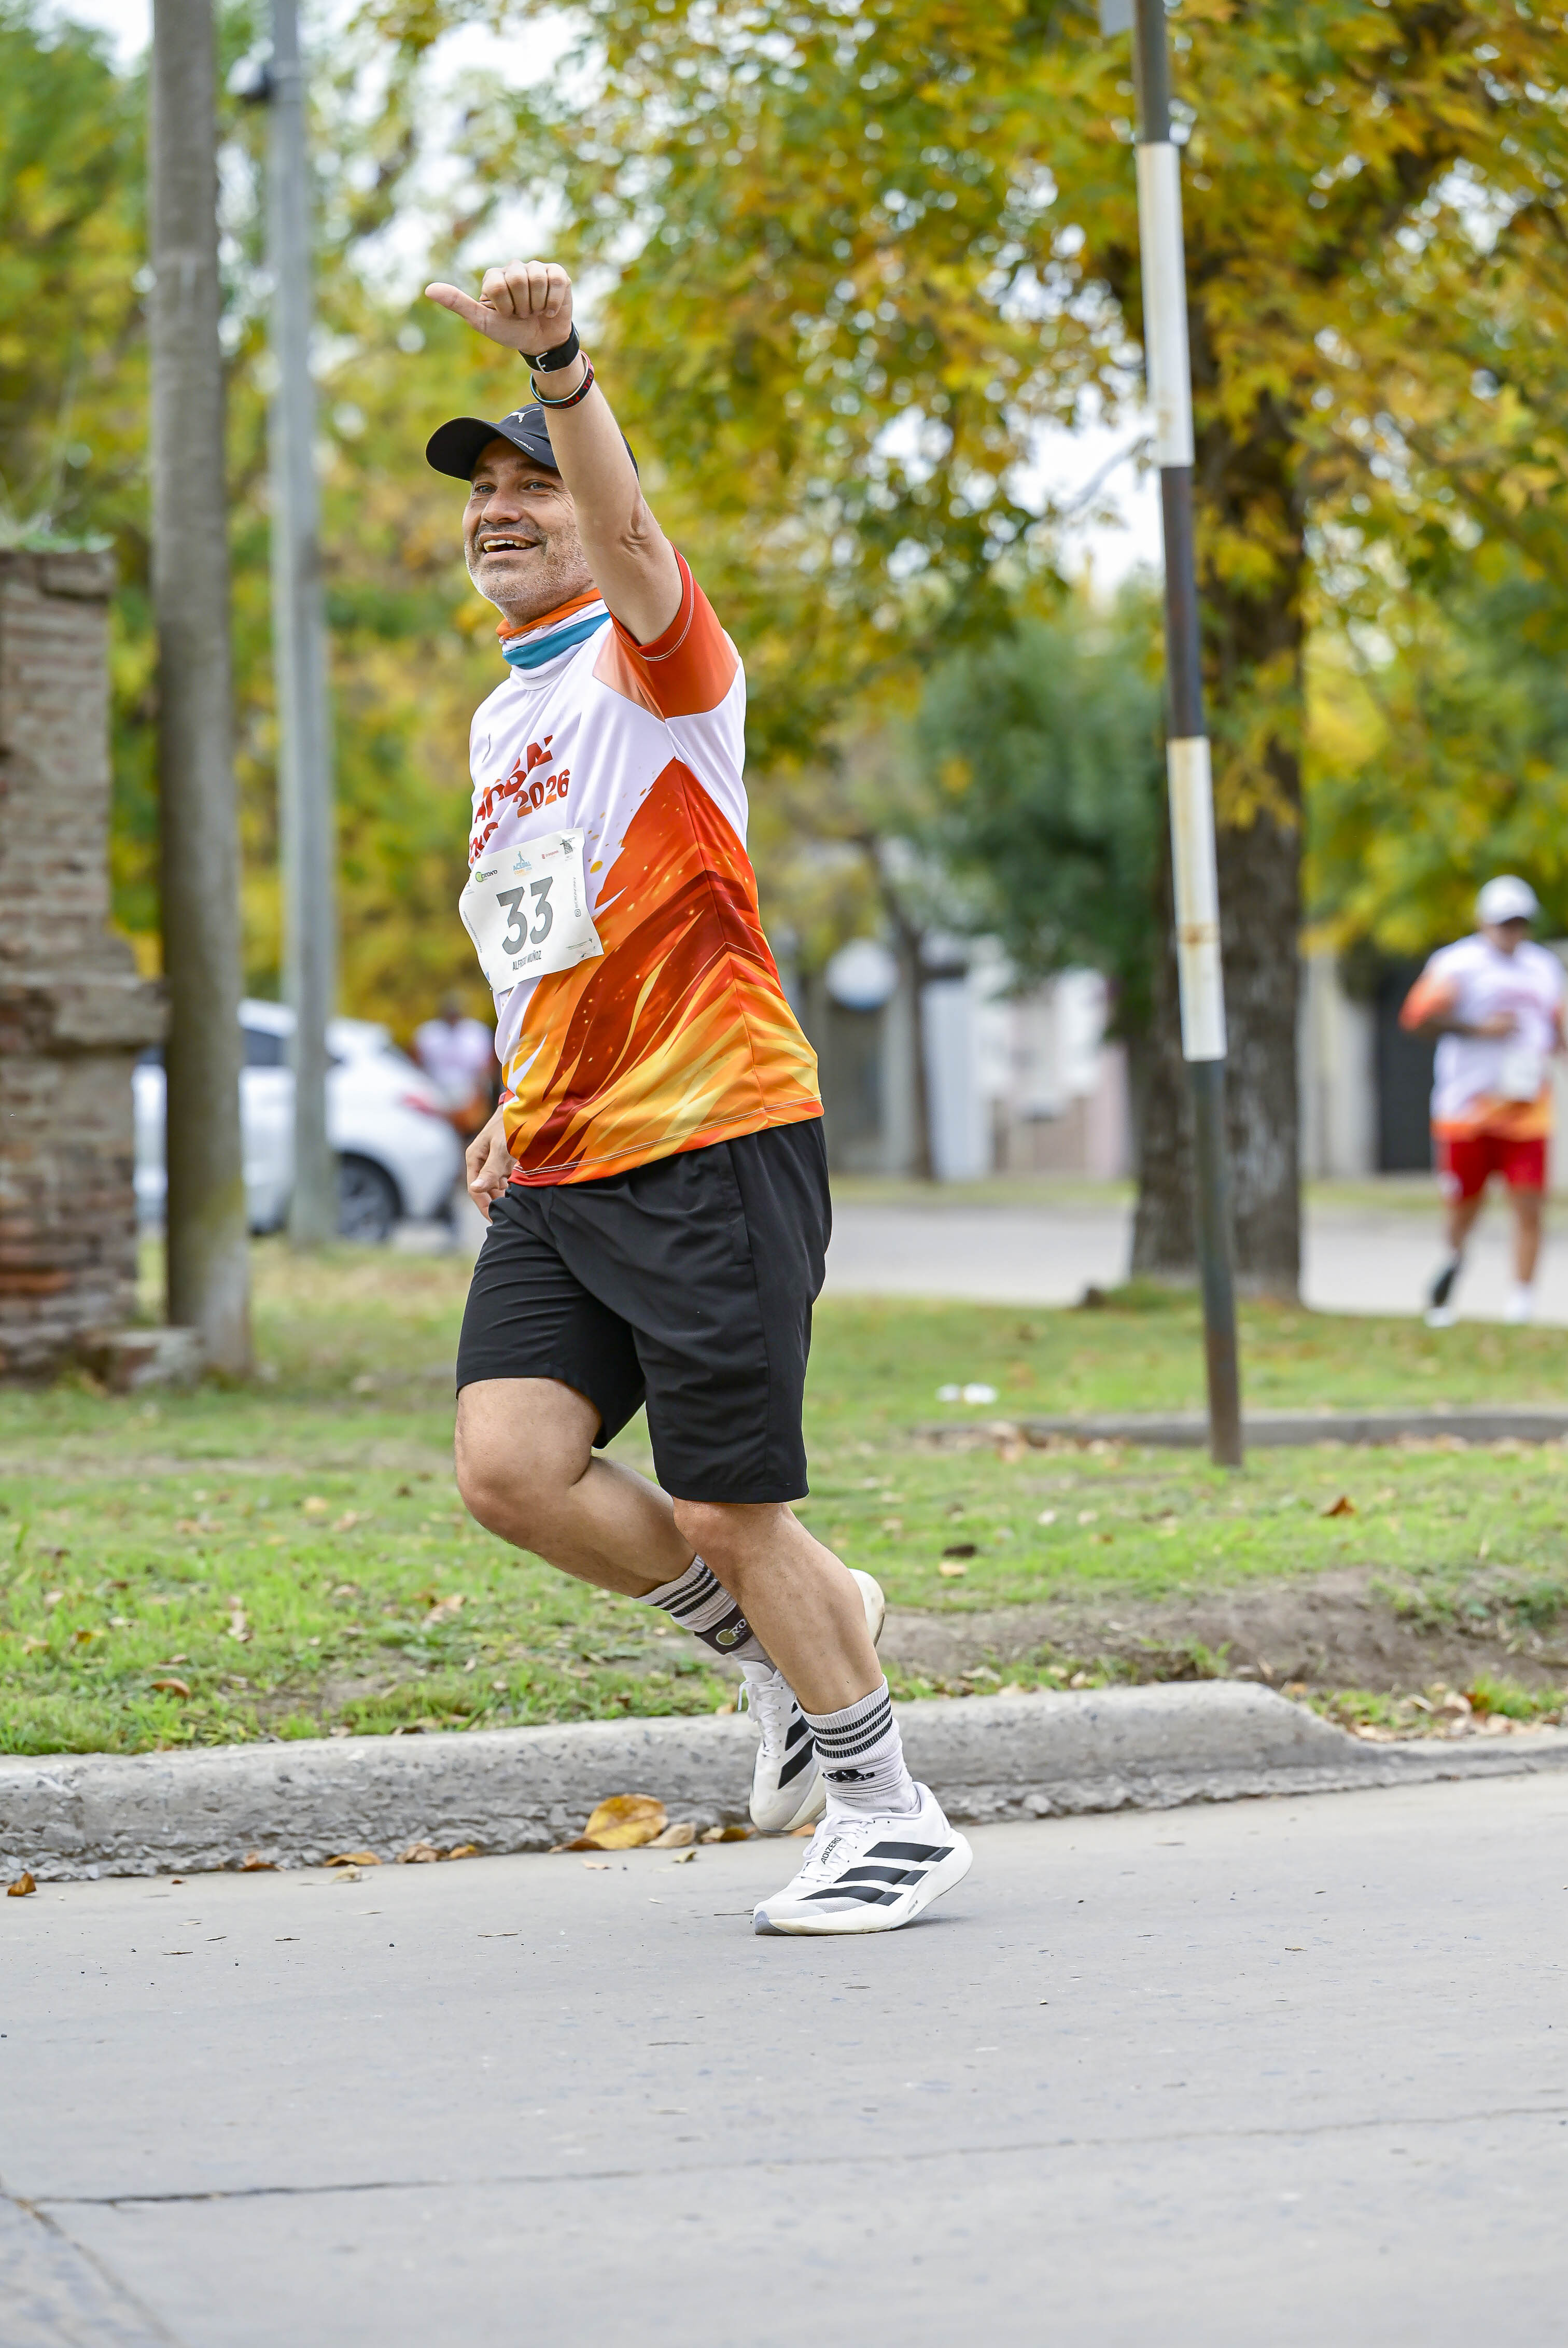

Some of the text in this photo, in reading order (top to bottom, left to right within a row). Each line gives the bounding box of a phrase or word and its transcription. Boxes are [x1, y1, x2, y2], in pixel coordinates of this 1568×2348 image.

[513, 769, 570, 818] 2026
[496, 876, 553, 955] 33
[820, 1836, 843, 1865] ADIZERO
